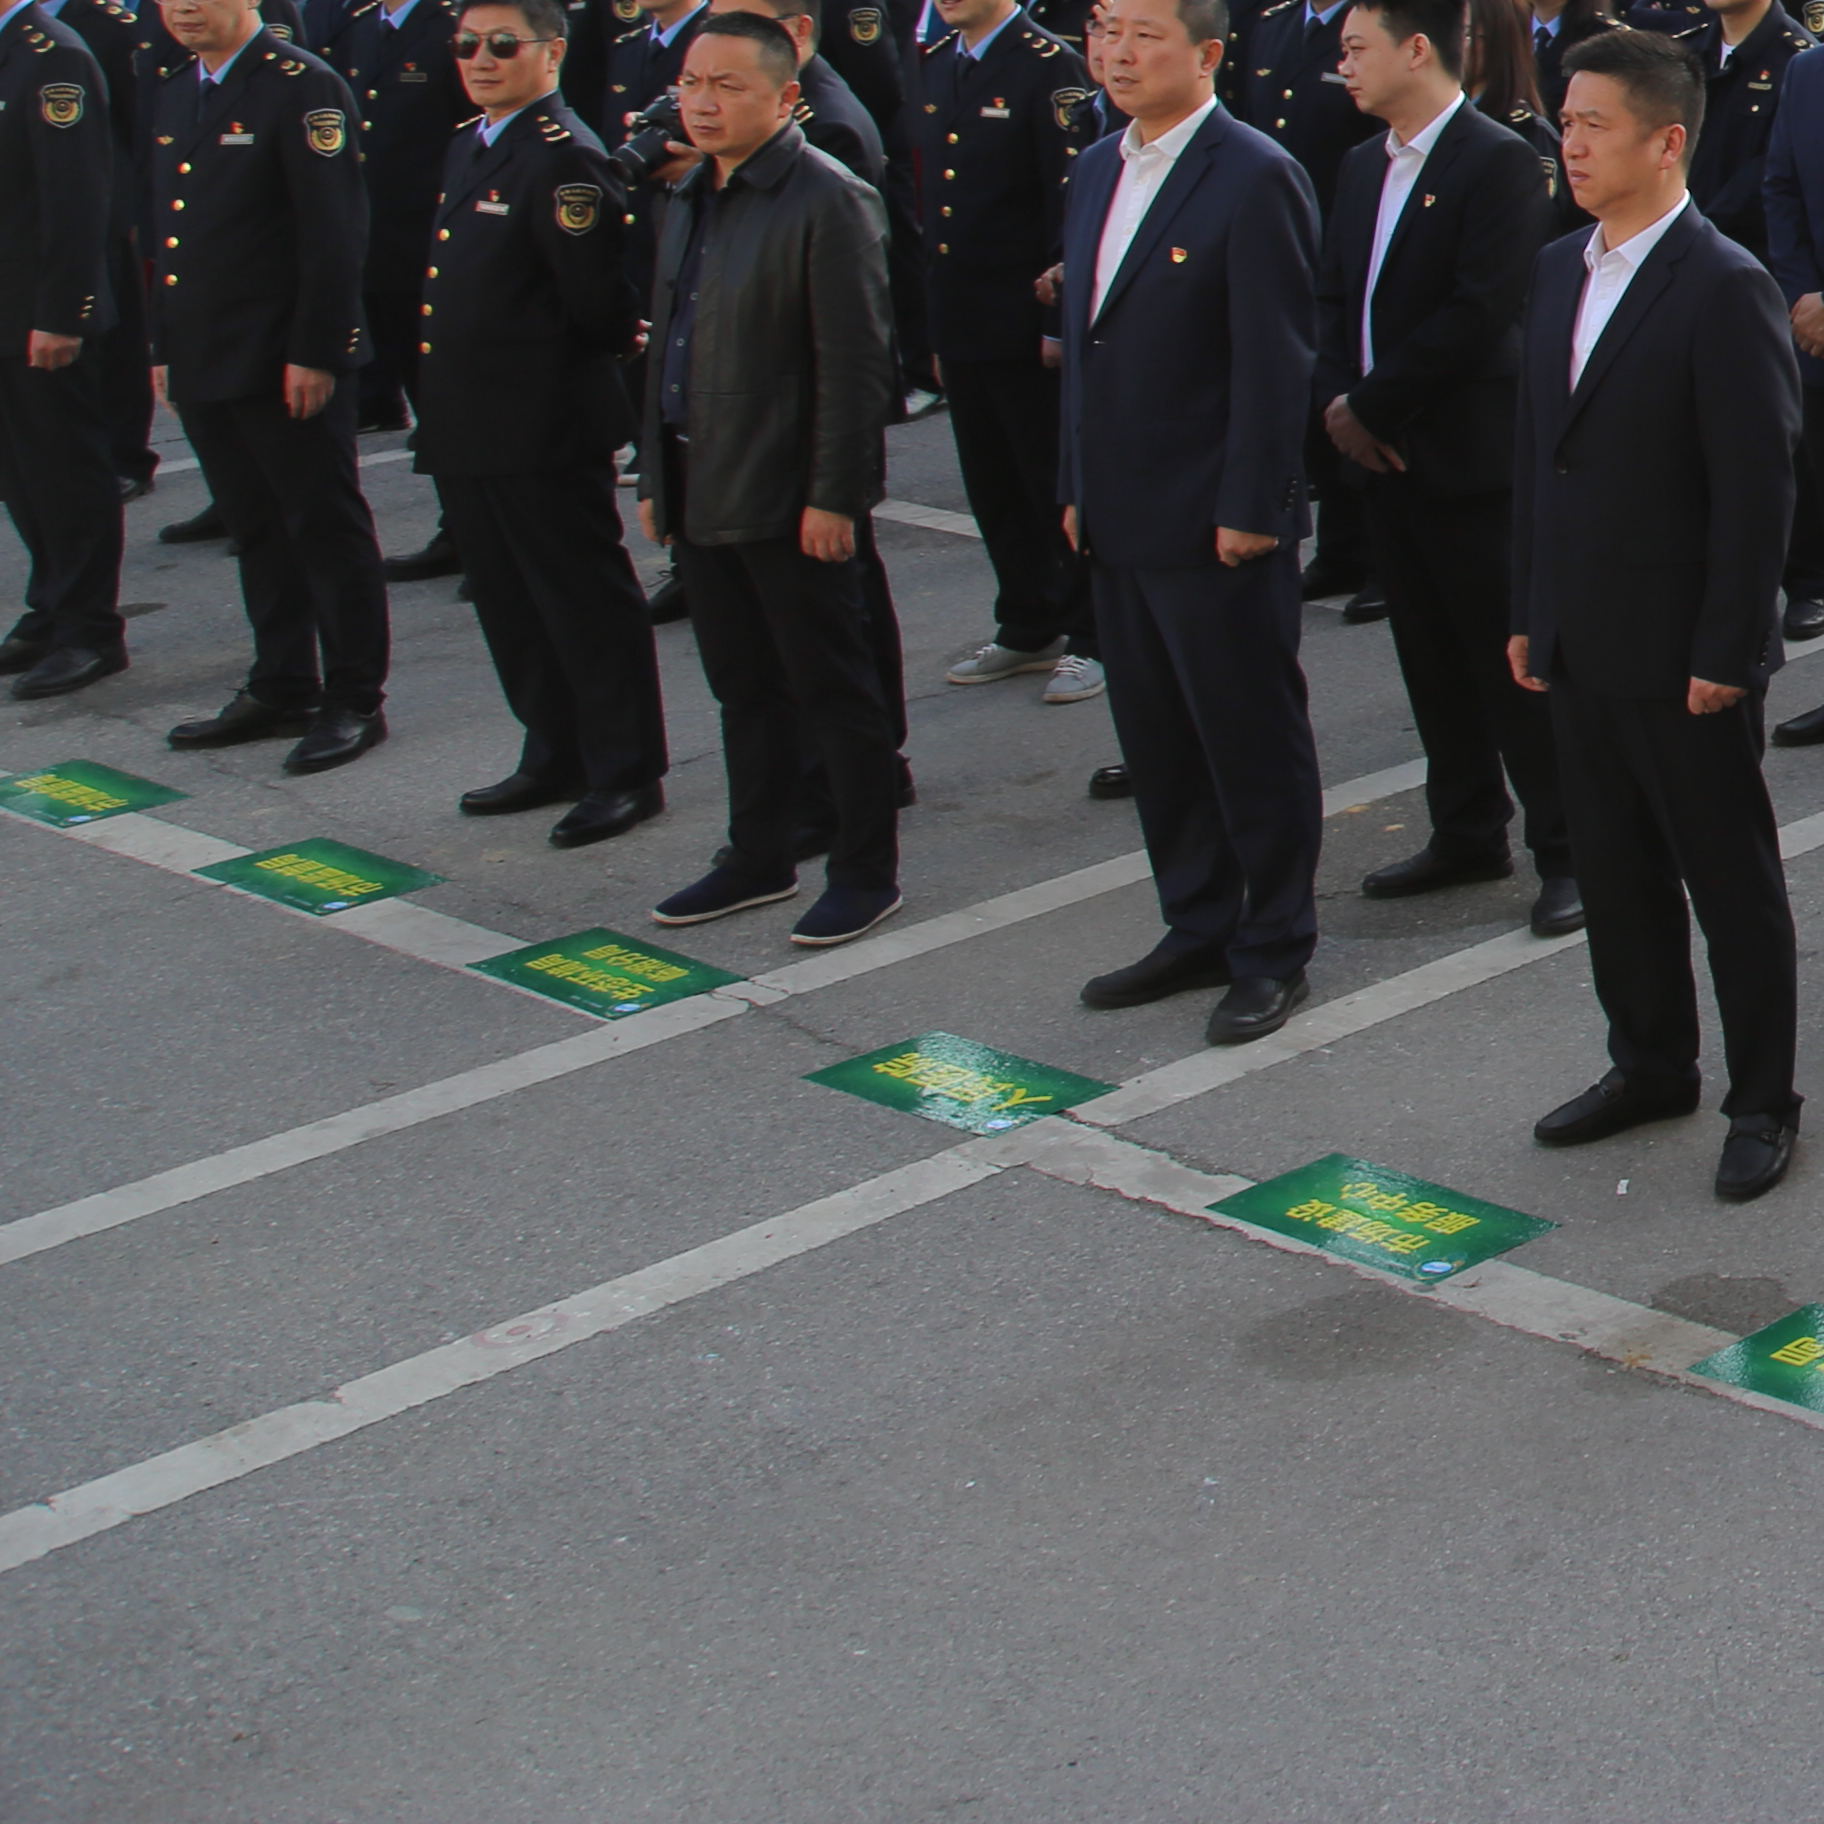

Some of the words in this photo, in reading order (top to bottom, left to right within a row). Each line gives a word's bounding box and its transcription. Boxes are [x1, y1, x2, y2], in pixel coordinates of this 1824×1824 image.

[1285, 1197, 1432, 1255] 市场建设
[1340, 1181, 1482, 1237] 服务中心
